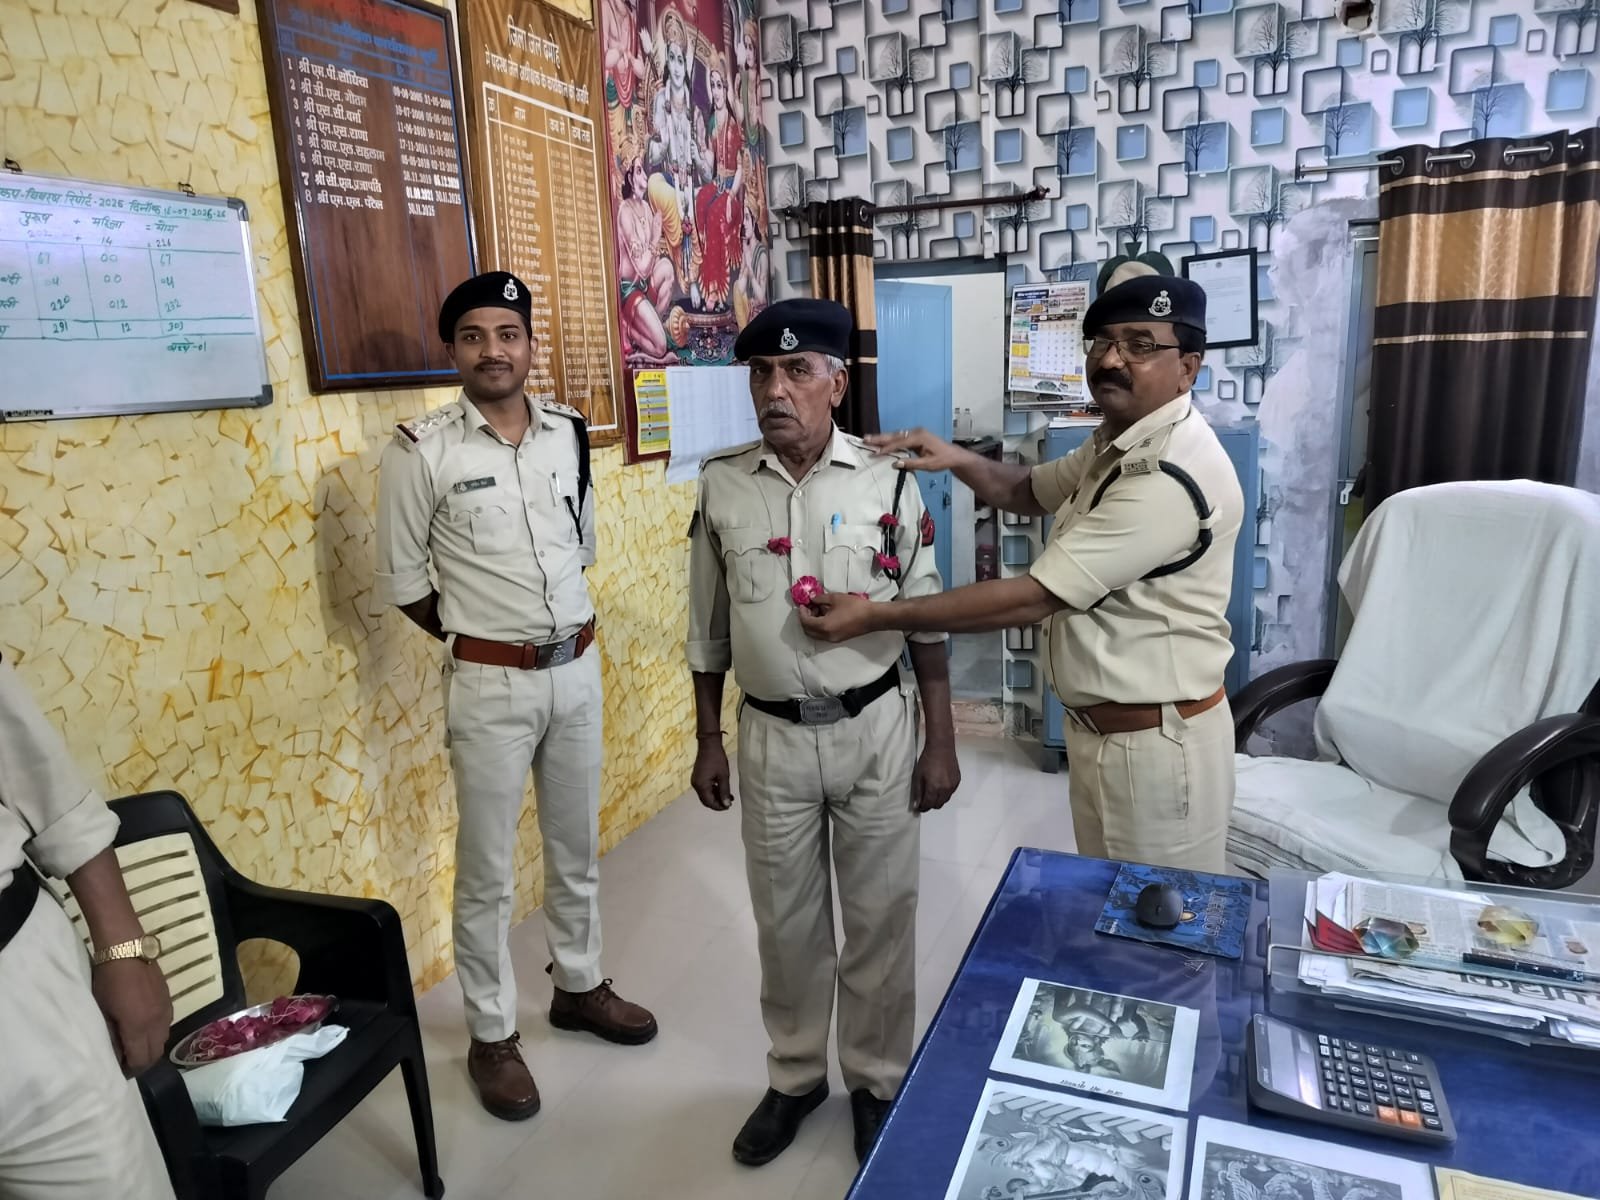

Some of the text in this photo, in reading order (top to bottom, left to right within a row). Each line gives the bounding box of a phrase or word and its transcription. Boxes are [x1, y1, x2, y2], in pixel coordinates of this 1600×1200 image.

[288, 58, 292, 70] 1
[299, 57, 310, 74] श्री
[290, 78, 295, 90] 2
[301, 78, 311, 94] श्री
[293, 98, 298, 110] 3
[304, 97, 315, 113] श्री
[295, 116, 300, 127] 4
[307, 115, 317, 131] श्री
[297, 135, 302, 146] 5
[309, 132, 319, 148] श्री
[301, 152, 306, 163] 6
[312, 150, 322, 166] श्री
[301, 172, 309, 186] 7
[315, 170, 326, 187] श्री
[305, 189, 312, 203] 8
[317, 190, 329, 205] श्री
[1426, 1117, 1439, 1125] 0
